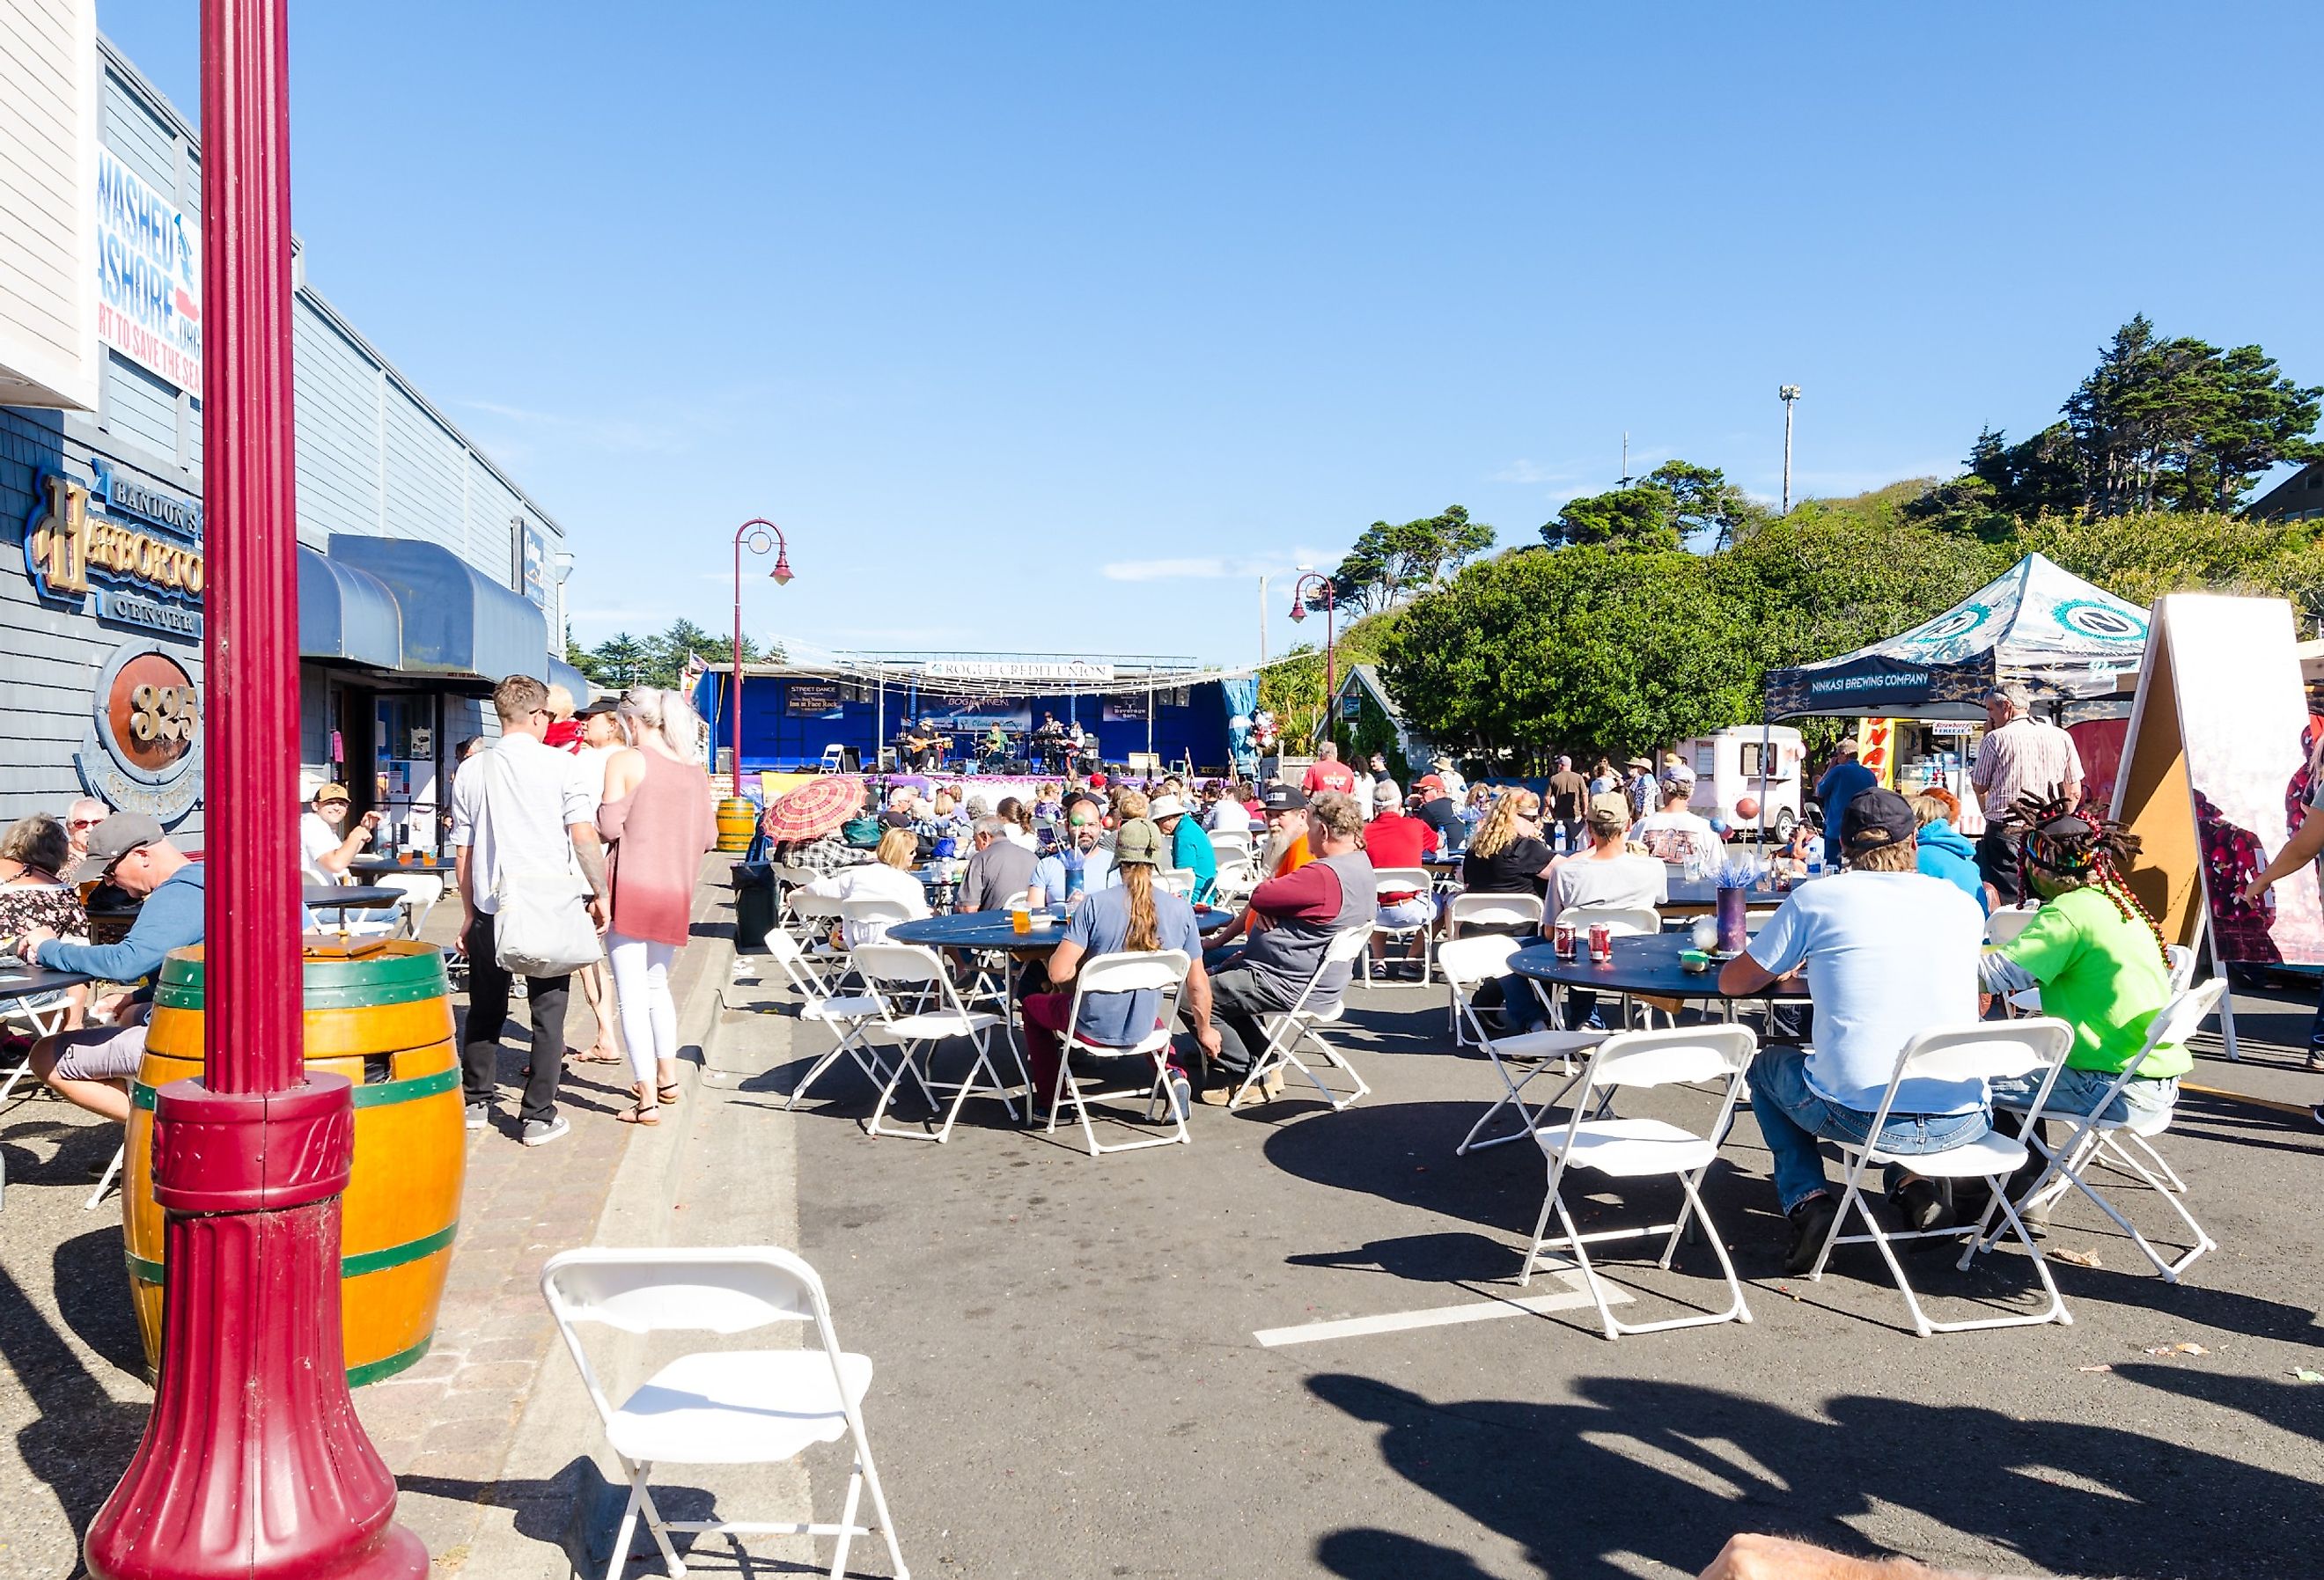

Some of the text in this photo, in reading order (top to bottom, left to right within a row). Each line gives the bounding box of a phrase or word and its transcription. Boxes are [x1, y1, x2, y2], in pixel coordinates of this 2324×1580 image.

[98, 151, 174, 273] WASHED
[115, 312, 130, 349] TO
[133, 322, 159, 368] SAVE
[161, 339, 180, 380] THE
[114, 599, 194, 632] CENTER
[2078, 612, 2129, 633] N
[945, 664, 1106, 677] ROGUE CREDIT UNION
[1812, 672, 1929, 693] NINKASI BREWING COMPANY
[130, 684, 198, 741] 325
